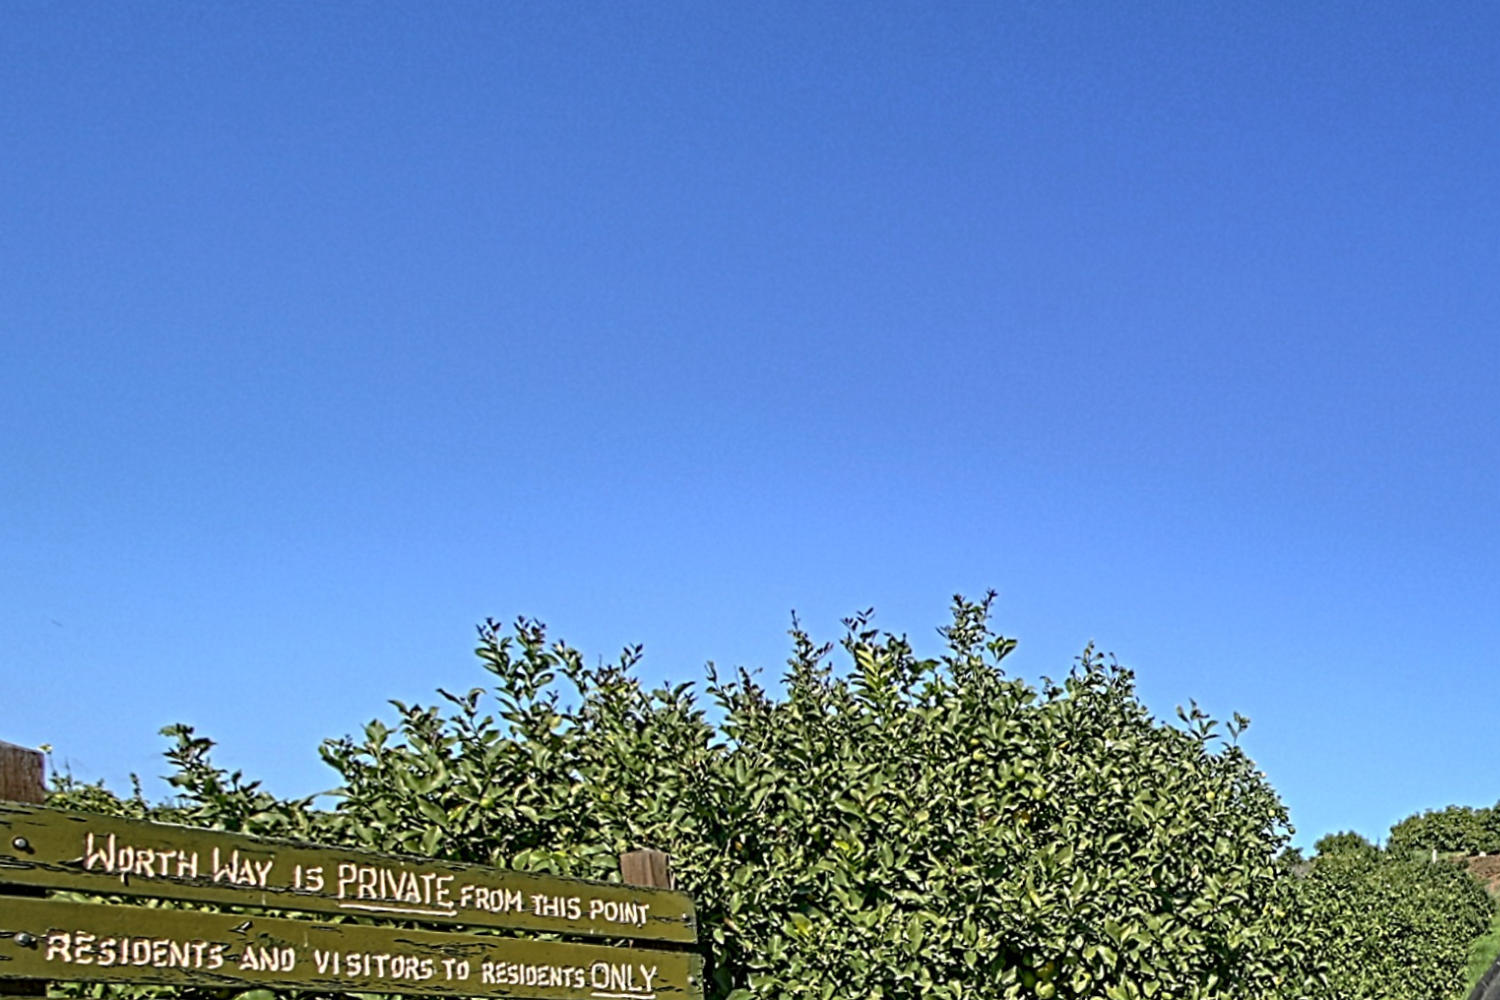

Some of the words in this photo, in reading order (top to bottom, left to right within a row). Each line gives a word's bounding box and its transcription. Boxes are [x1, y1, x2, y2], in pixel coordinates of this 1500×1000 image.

[85, 832, 198, 878] WORTH
[212, 847, 273, 887] WAY
[294, 864, 324, 891] IS
[338, 862, 454, 909] PRIVATE
[460, 885, 522, 913] FROM
[530, 894, 581, 921] THIS
[589, 899, 650, 929] POINT
[46, 930, 225, 969] RESIDENTS
[239, 945, 296, 973] AND
[314, 949, 434, 981] VISITORS
[442, 958, 470, 981] TO
[481, 962, 585, 989] RESIDENTS
[590, 961, 657, 993] ONLY
